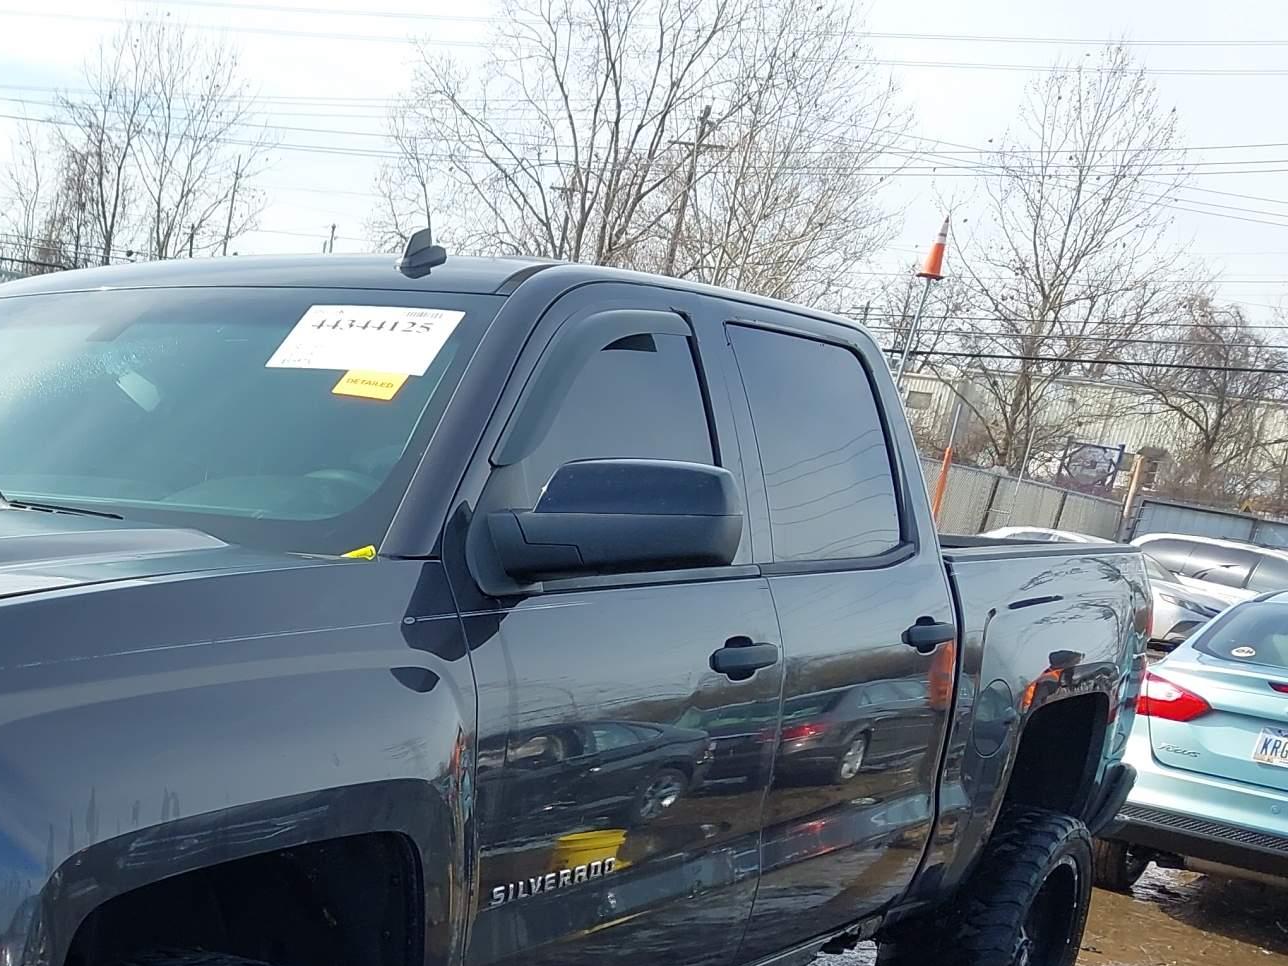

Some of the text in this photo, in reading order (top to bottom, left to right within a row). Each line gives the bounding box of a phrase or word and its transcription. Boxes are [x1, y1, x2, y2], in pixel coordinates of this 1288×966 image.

[312, 319, 435, 334] 44344125
[346, 377, 395, 389] DETAILED
[489, 857, 617, 906] SILVERADO
